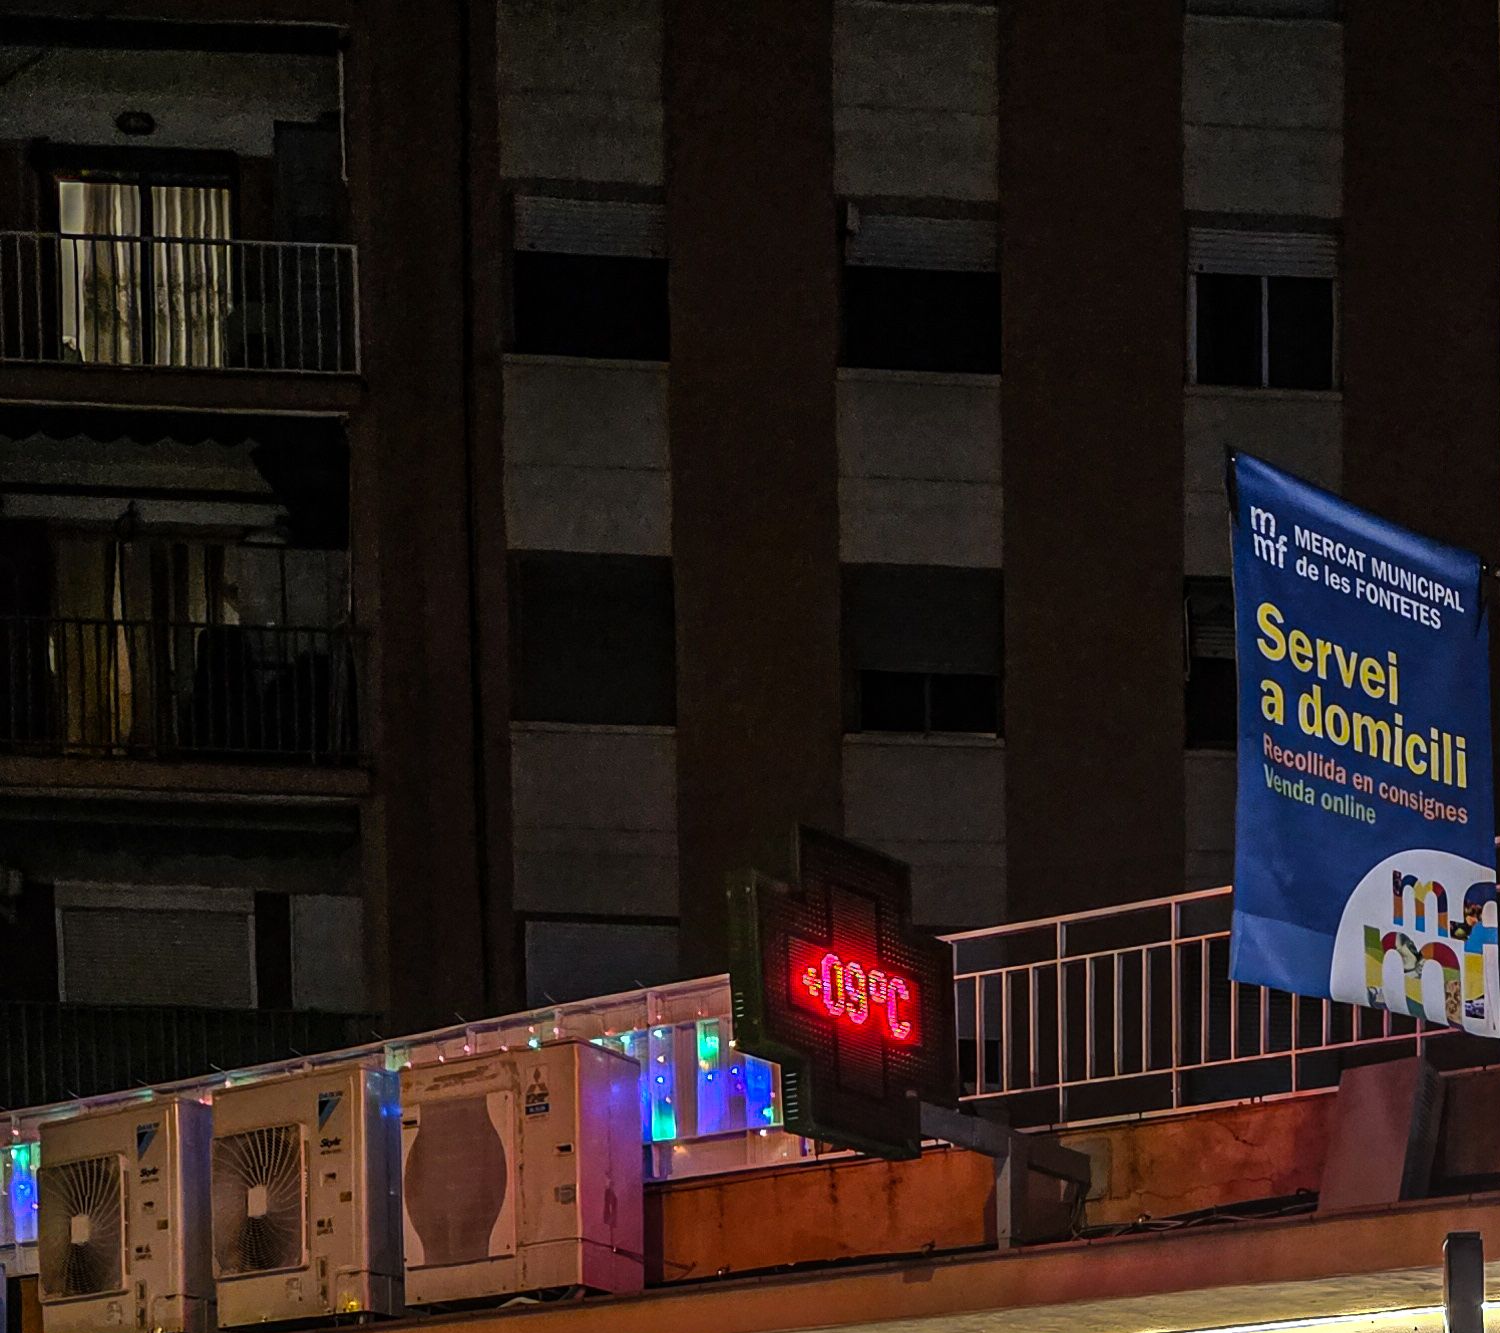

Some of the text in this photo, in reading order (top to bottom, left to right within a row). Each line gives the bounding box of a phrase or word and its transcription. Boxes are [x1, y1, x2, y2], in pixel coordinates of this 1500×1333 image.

[1293, 524, 1465, 613] MERCAT MUNICIPAL
[1296, 556, 1442, 630] de les FONTETES
[1256, 602, 1399, 706] Servei
[1260, 679, 1468, 789] a domicili
[1263, 732, 1469, 825] Recollida en consignes
[1263, 763, 1377, 825] Venda online
